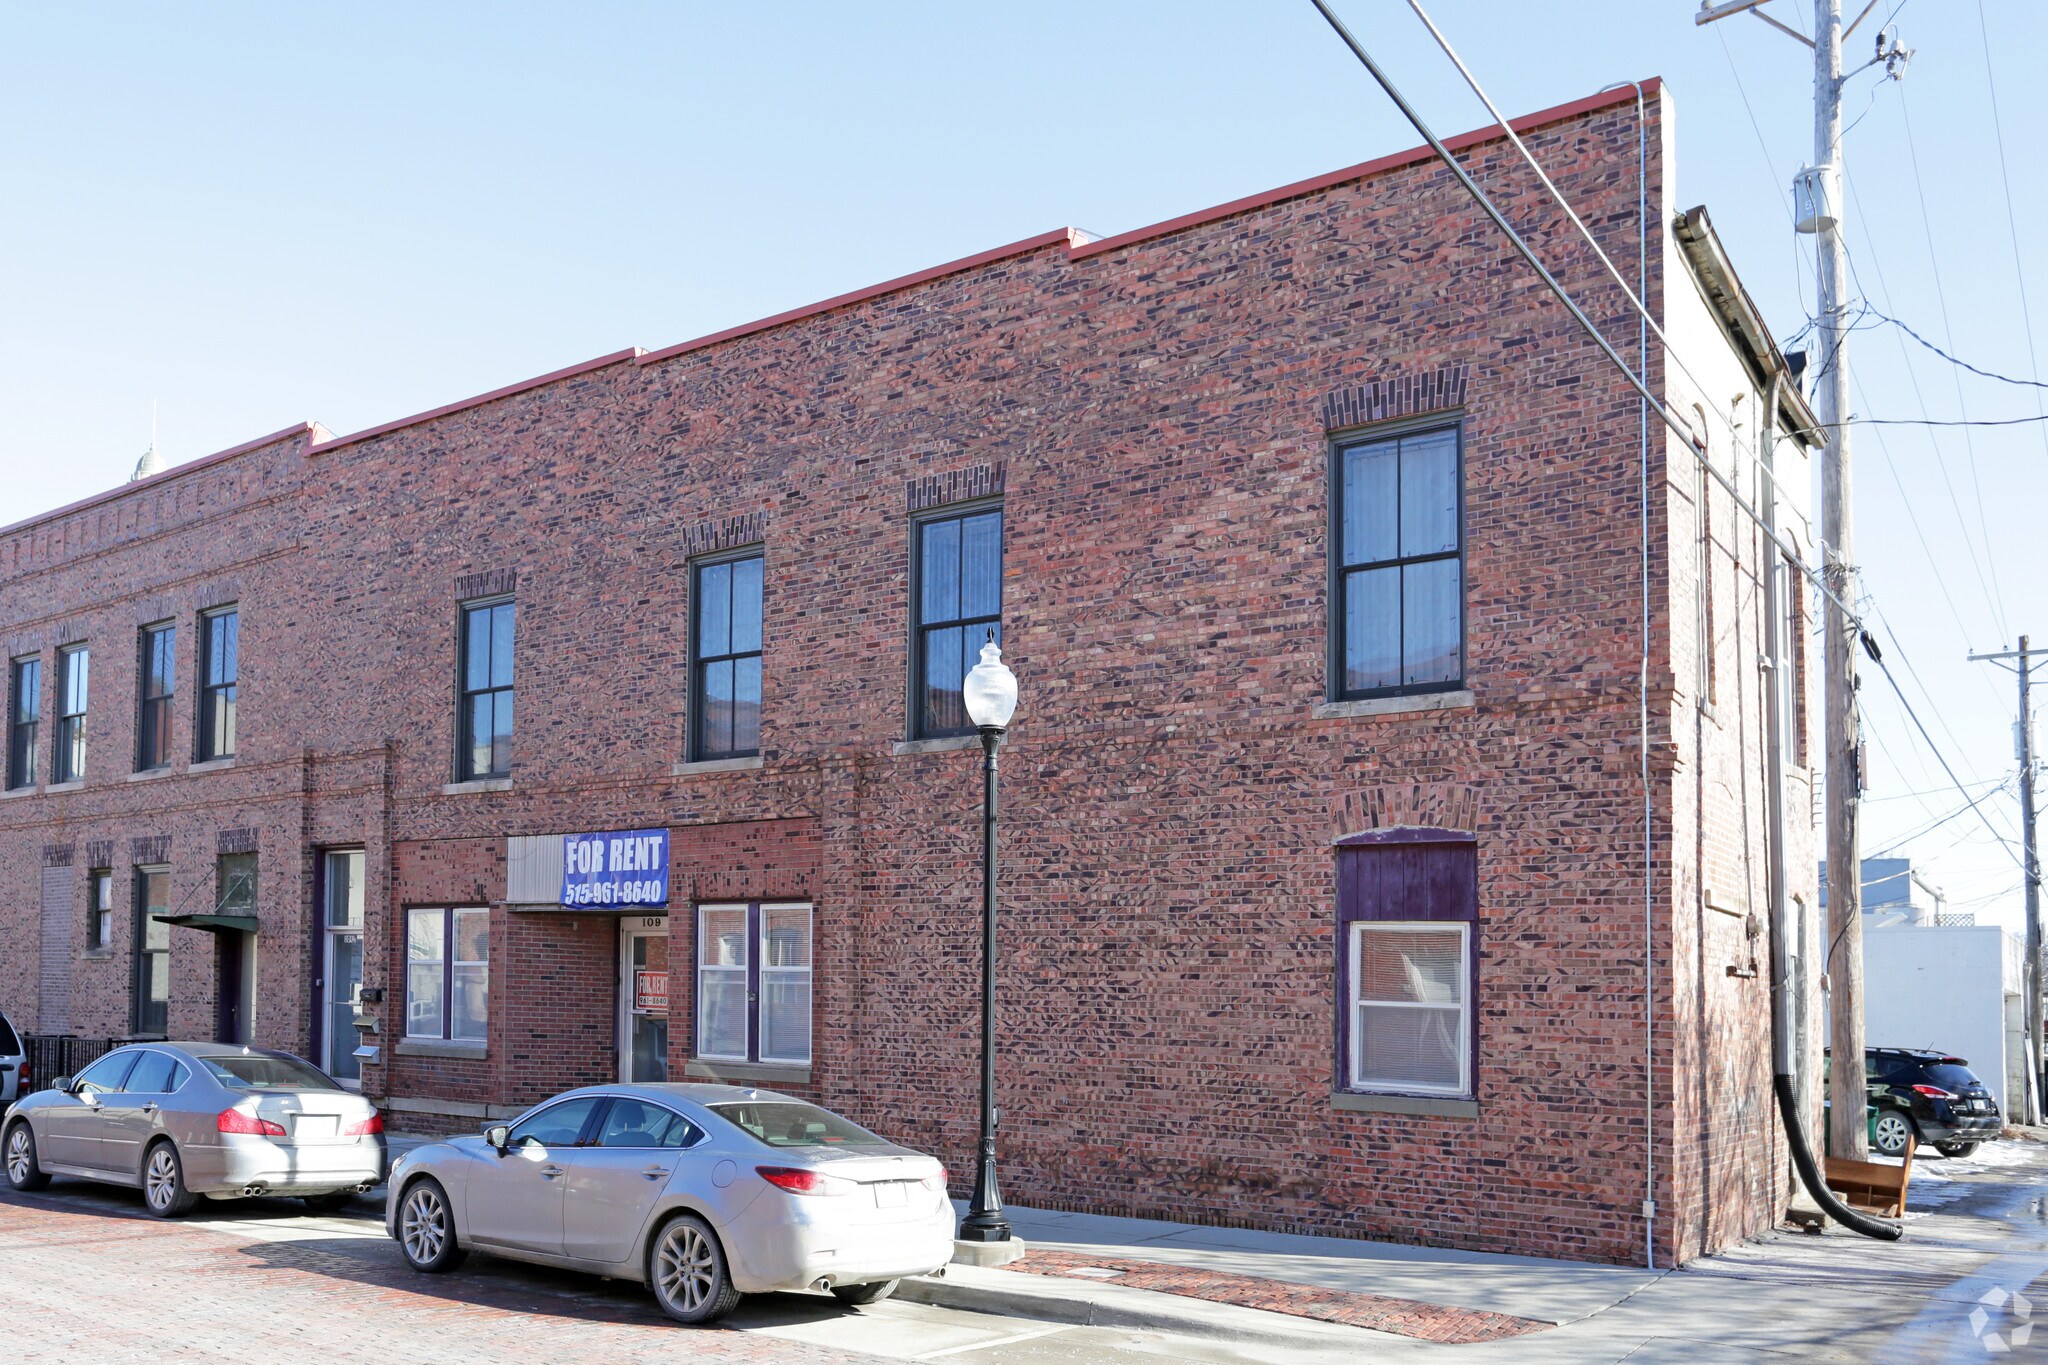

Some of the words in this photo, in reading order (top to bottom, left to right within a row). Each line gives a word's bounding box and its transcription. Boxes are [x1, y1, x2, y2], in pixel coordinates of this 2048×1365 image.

[567, 840, 604, 874] FOR
[609, 836, 663, 872] RENT
[565, 880, 661, 905] 515-961-8640
[642, 918, 661, 927] 109
[639, 975, 652, 994] FOR
